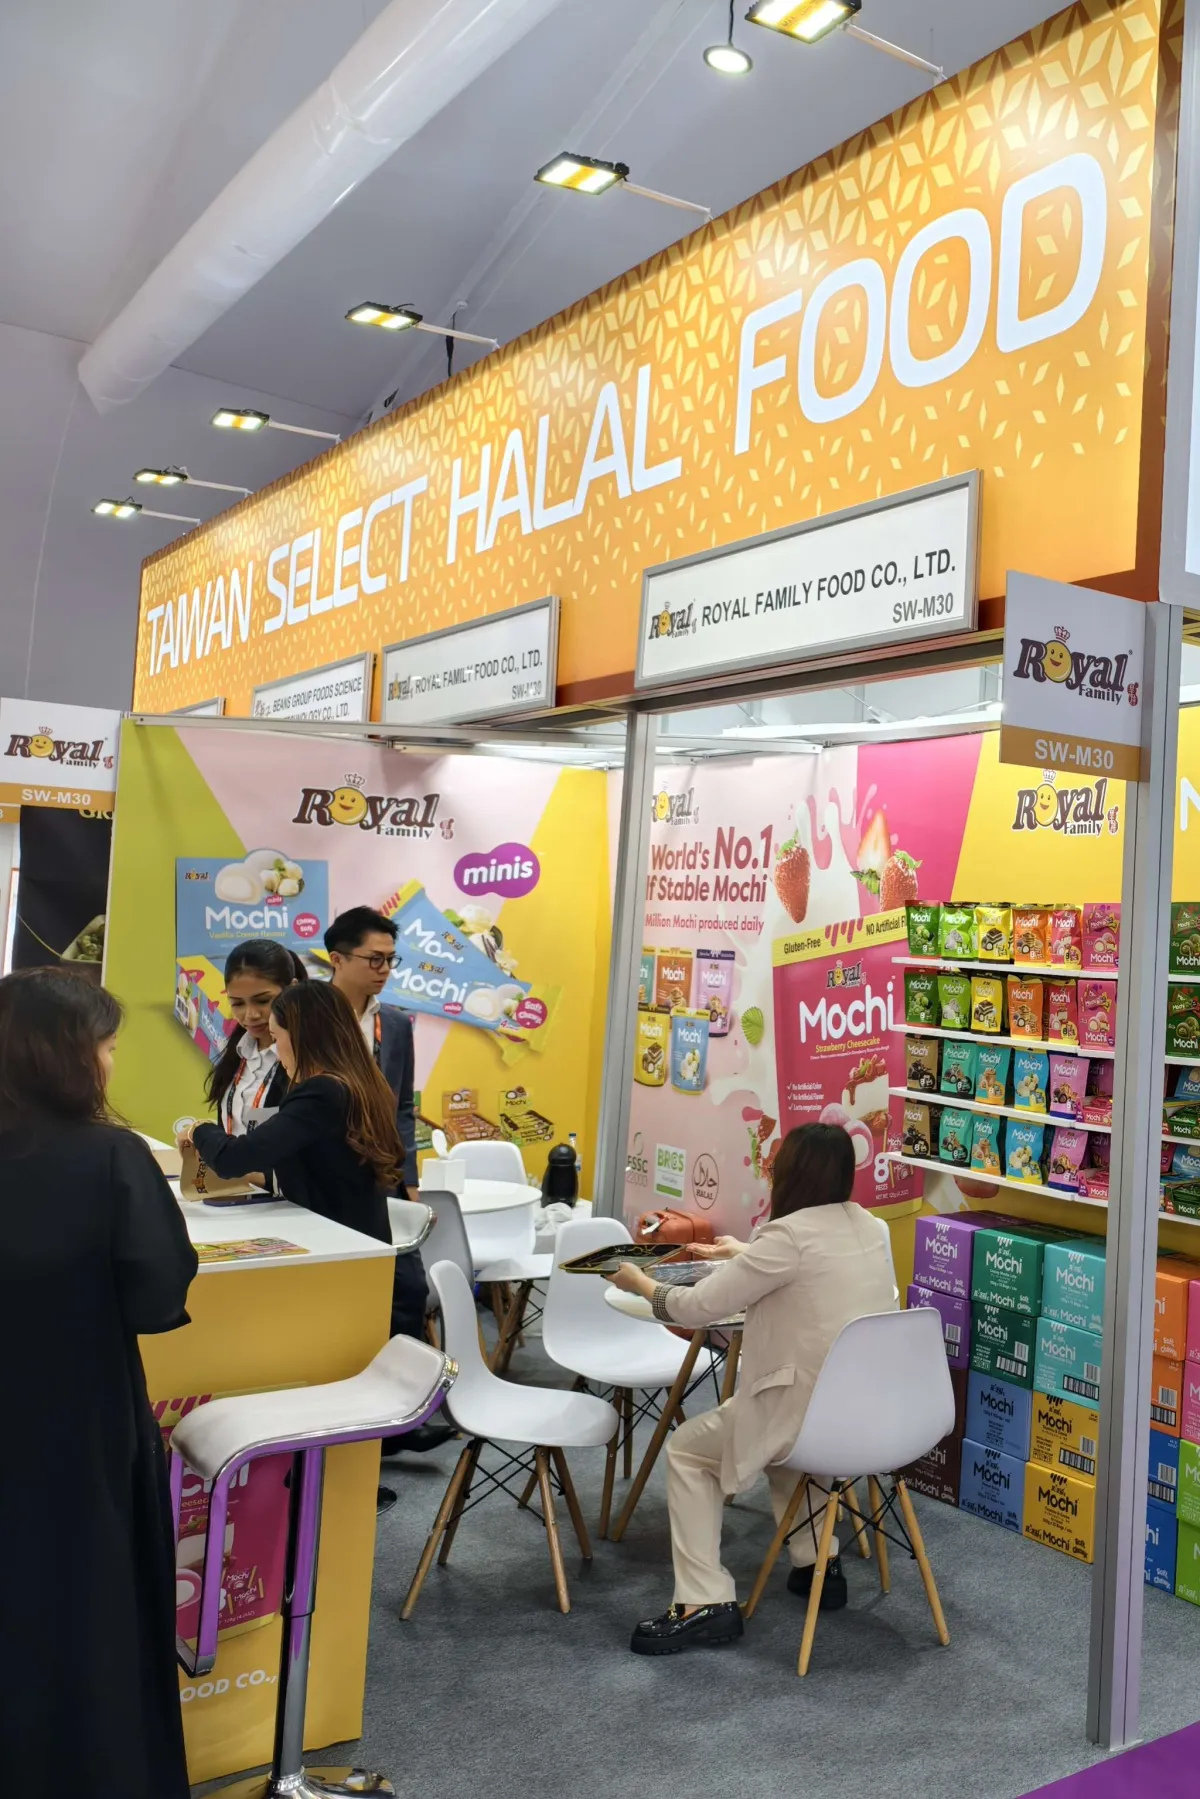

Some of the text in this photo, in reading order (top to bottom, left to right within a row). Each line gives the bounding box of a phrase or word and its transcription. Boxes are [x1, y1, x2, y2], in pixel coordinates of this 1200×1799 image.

[146, 152, 1108, 677] TAIWAN SELECT HALAL FOOD
[701, 548, 956, 627] ROYAL FAMILY FOOD CO., LTD.
[893, 592, 953, 623] SW-M30
[416, 678, 441, 694] ROYAL
[474, 659, 498, 680] FOOD
[522, 650, 543, 669] LTD.
[1013, 637, 1130, 693] Royal
[273, 697, 291, 712] BEANS
[292, 691, 312, 707] GROUP
[313, 685, 334, 701] FOODS
[335, 677, 361, 696] SCIENCE
[1078, 684, 1122, 706] Family
[336, 703, 349, 718] LTD.
[4, 734, 104, 761] Royal
[1034, 739, 1114, 770] SW-M30
[22, 789, 91, 805] SW-M30
[1012, 777, 1109, 832] Royal
[292, 787, 440, 830] Royal
[376, 824, 433, 840] Family
[1064, 820, 1103, 837] Family
[652, 824, 773, 870] World's No.1
[463, 856, 533, 886] minis
[658, 875, 709, 901] Stable
[713, 874, 767, 902] Mochi
[205, 905, 289, 929] Mochi
[645, 912, 764, 935] Million Mochi produced daily
[866, 923, 874, 935] NO
[876, 919, 900, 932] Artificial
[910, 912, 932, 923] Mochi
[1055, 917, 1075, 928] Mochi
[784, 938, 821, 954] Gluten-Free
[1091, 953, 1113, 963] Mochi
[1176, 955, 1200, 966] Mochi
[662, 967, 685, 980] Mochi
[701, 971, 727, 985] Mochi
[391, 967, 468, 1003] Mochi
[1011, 988, 1034, 1000] Mochi
[800, 981, 894, 1043] Mochi
[678, 1027, 702, 1043] Mochi
[816, 1042, 845, 1053] Strawberry
[847, 1036, 880, 1048] Cheesecake
[1085, 1032, 1107, 1042] Mochi
[1174, 1038, 1199, 1049] Mochi
[1054, 1064, 1080, 1076] Mochi
[874, 1152, 889, 1183] 8
[1090, 1188, 1108, 1198] Mochi
[925, 1237, 958, 1259] Mochi
[986, 1251, 1023, 1275] Mochi
[1038, 1410, 1073, 1434] Mochi
[1038, 1486, 1078, 1517] Mochi
[226, 1572, 249, 1582] Mochi
[179, 1678, 230, 1703] OOD
